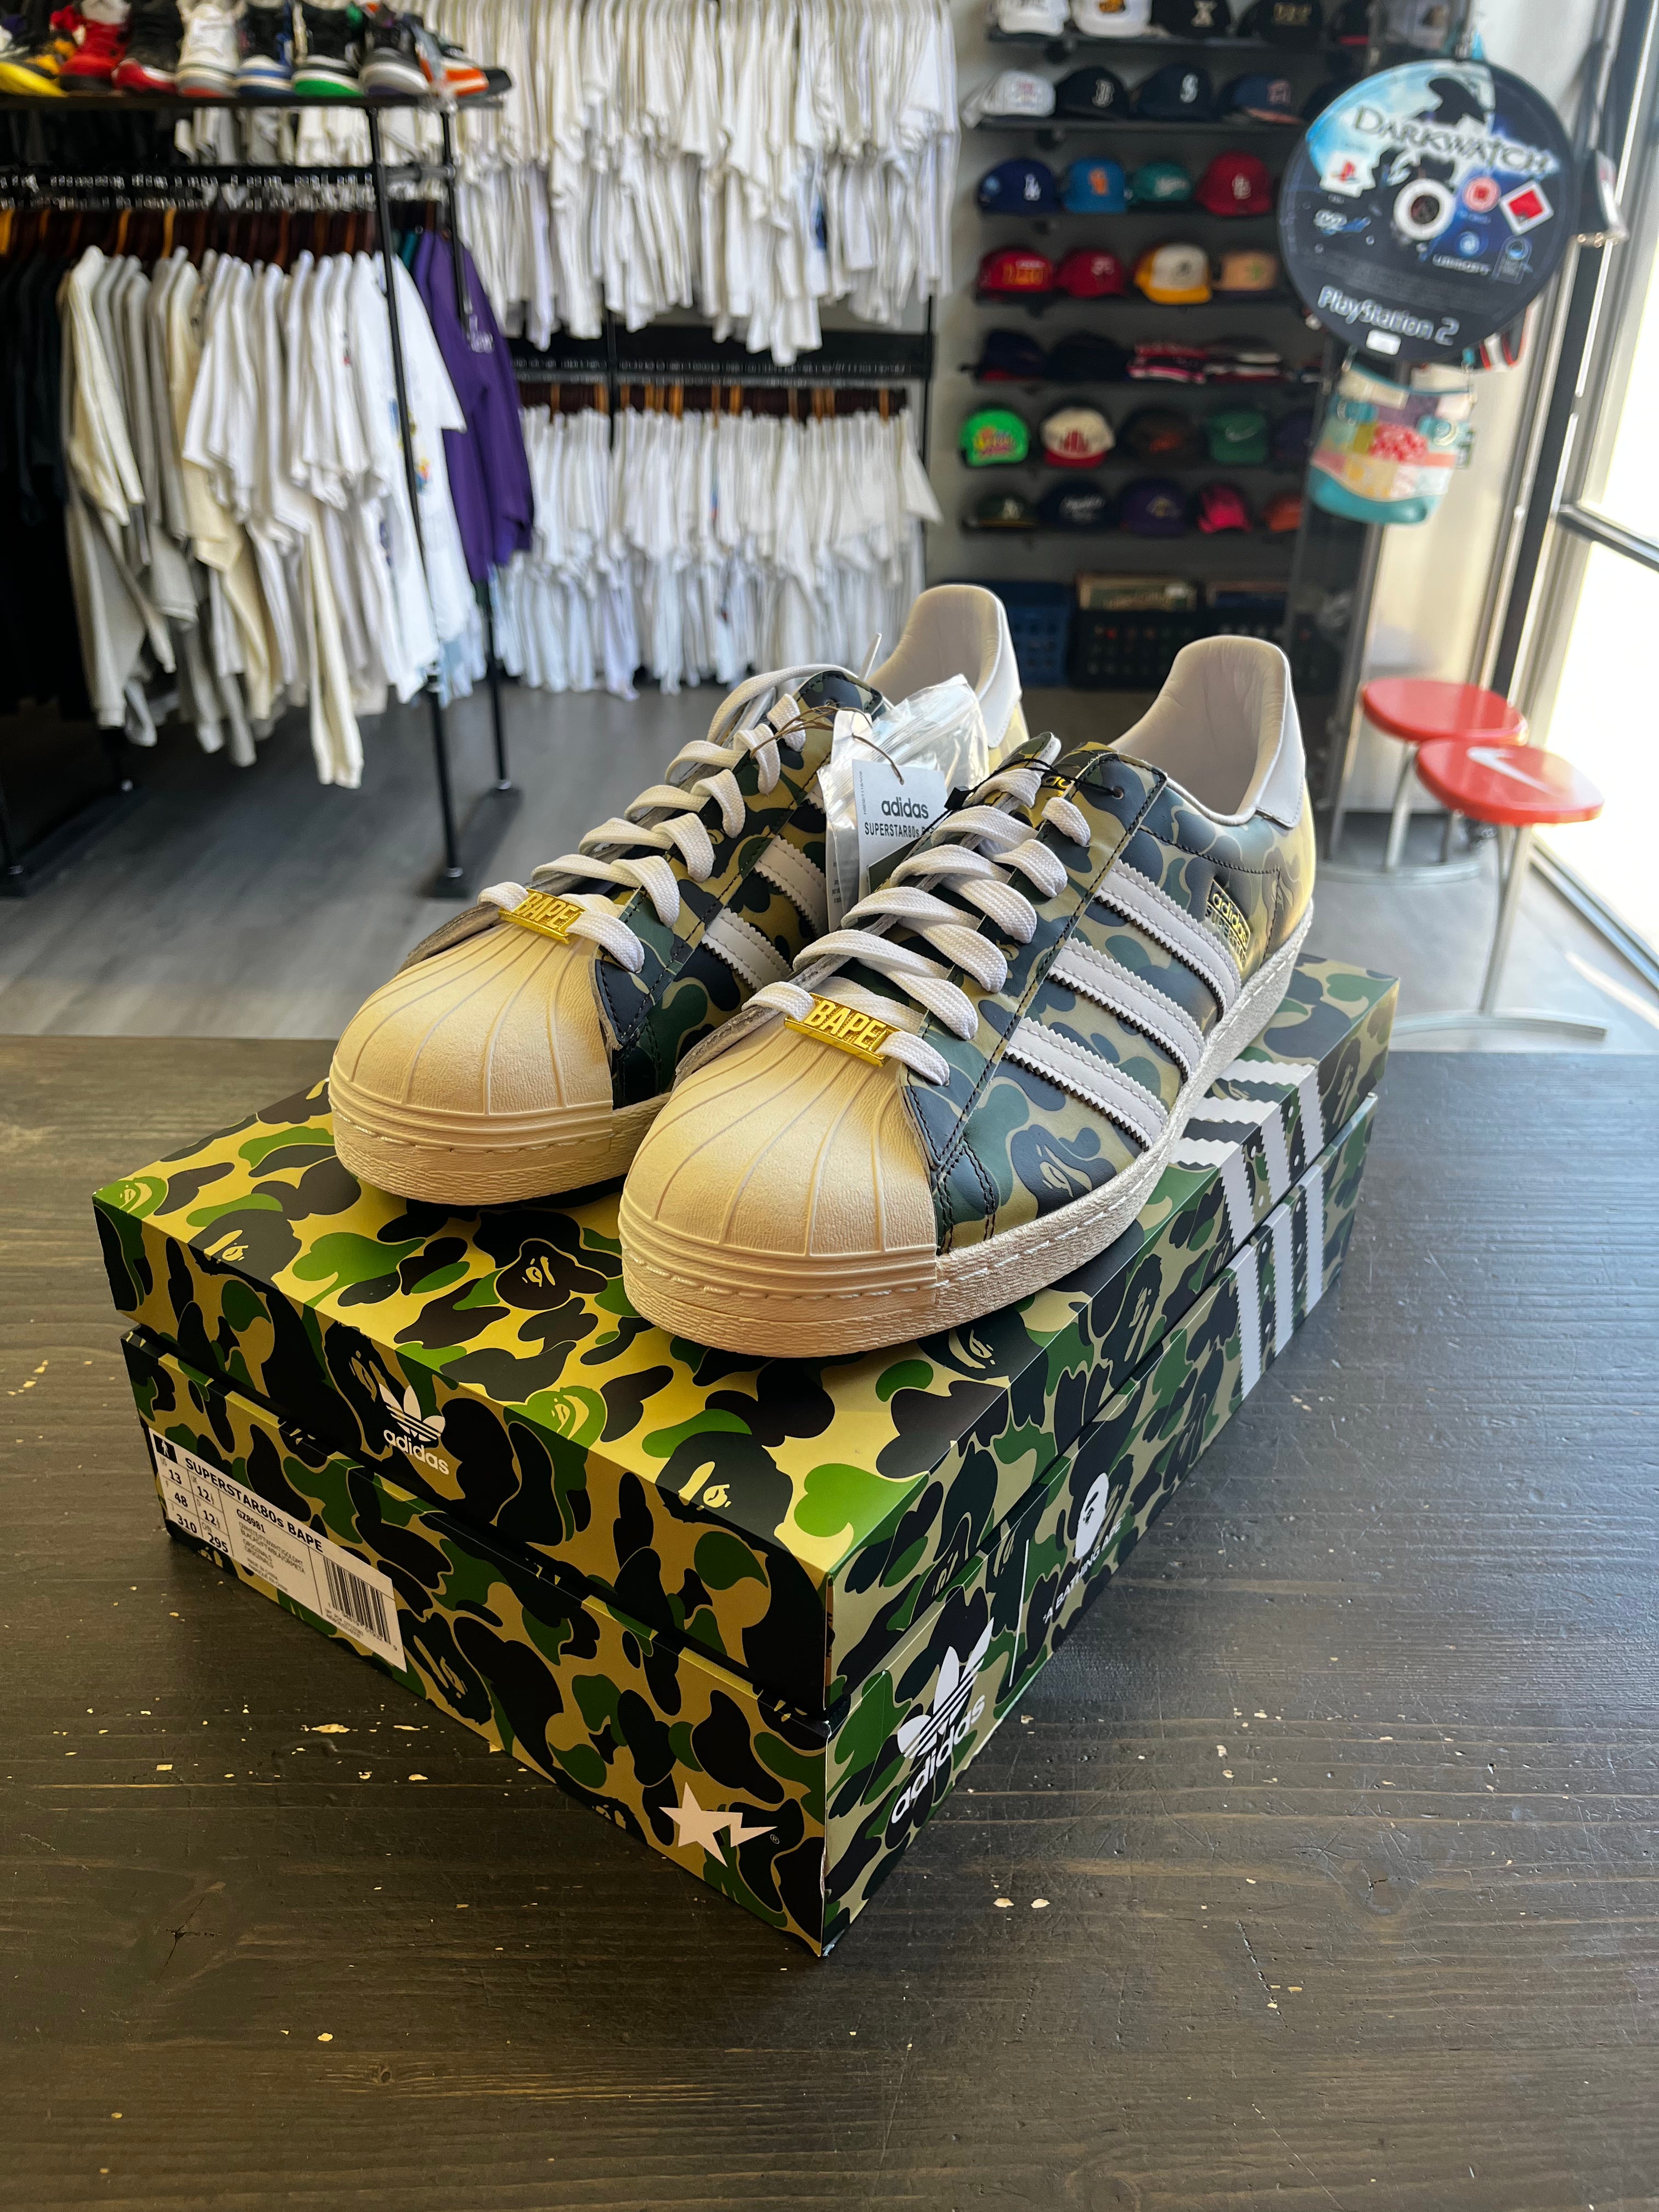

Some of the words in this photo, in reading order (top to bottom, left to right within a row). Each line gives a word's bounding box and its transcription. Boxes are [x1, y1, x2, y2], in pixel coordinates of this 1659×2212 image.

[1356, 106, 1550, 176] DARKWATCH
[1318, 285, 1435, 341] PlayStation
[1434, 316, 1460, 346] 2
[881, 797, 929, 820] adidas
[865, 822, 919, 838] SUPERSTAR80s
[513, 892, 579, 928] BAPE
[1213, 893, 1247, 947] adidas
[803, 1000, 887, 1049] BAPE
[383, 1429, 449, 1475] adidas
[169, 1470, 182, 1485] 13
[174, 1493, 188, 1507] 48
[185, 1458, 284, 1528] SUPERSTAR80s
[287, 1522, 323, 1553] BAPE
[176, 1514, 197, 1533] 310
[236, 1509, 266, 1533] GZ8981
[208, 1533, 228, 1553] 295
[1056, 1545, 1101, 1610] BATHING
[891, 1695, 985, 1824] adidas
